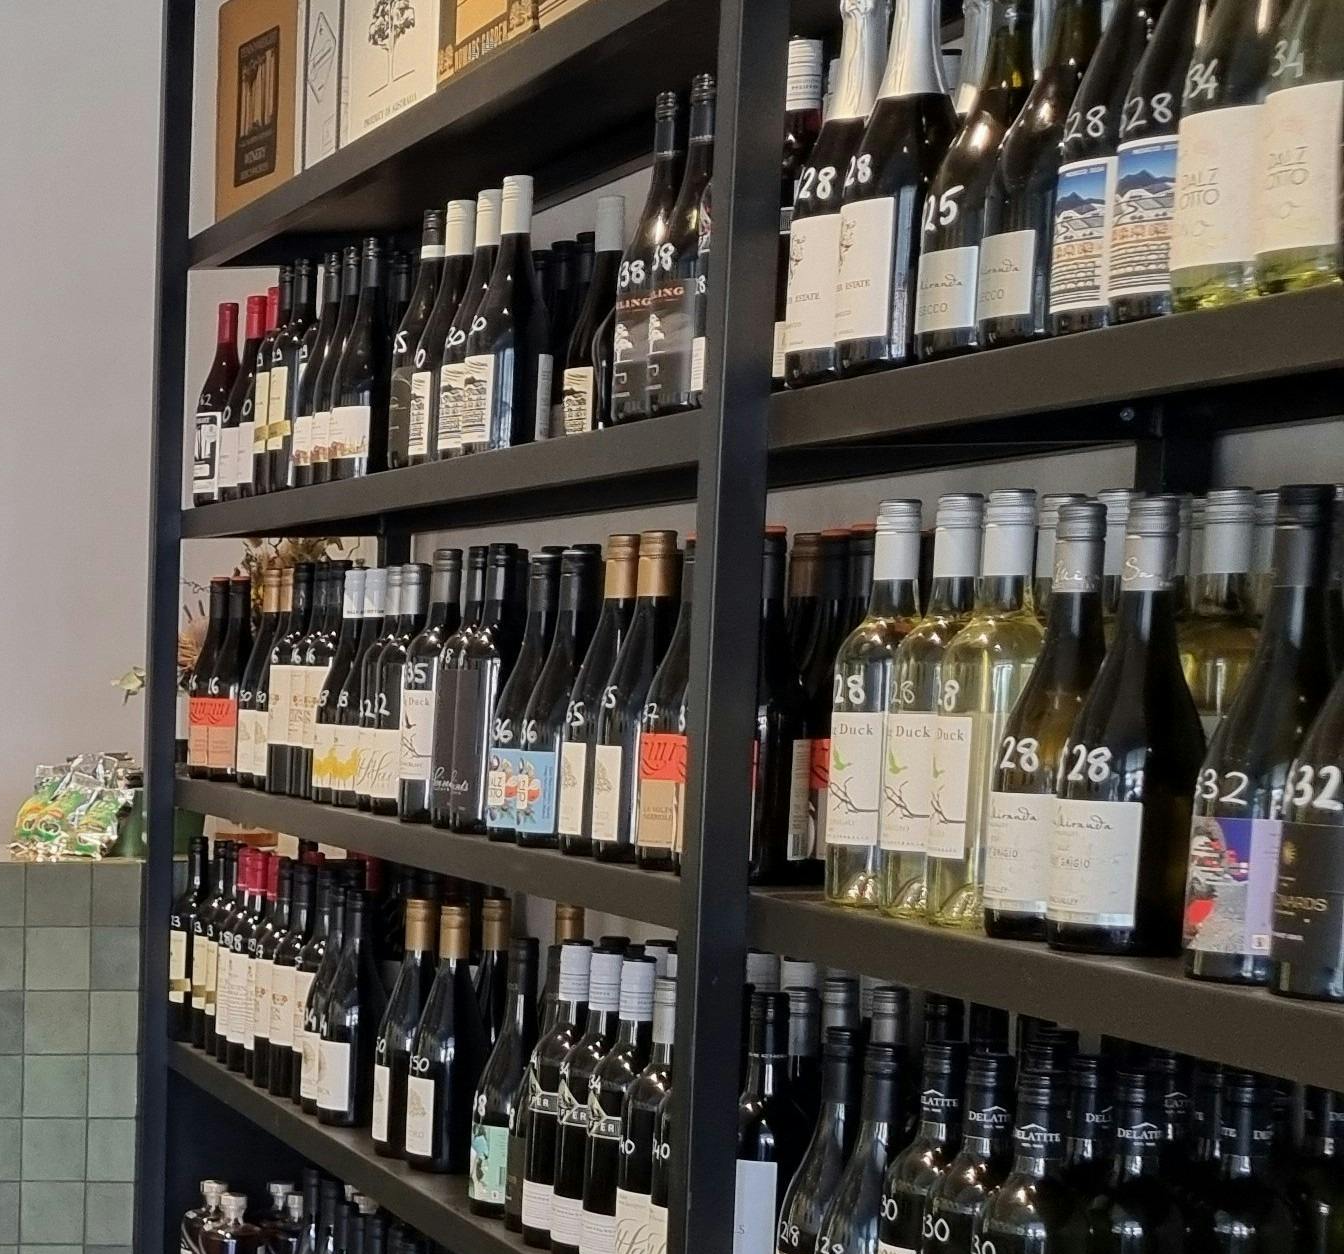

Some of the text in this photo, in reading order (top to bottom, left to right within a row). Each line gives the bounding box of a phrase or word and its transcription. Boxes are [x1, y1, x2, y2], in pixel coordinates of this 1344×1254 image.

[798, 166, 837, 200] 28
[834, 673, 865, 705] 28
[840, 723, 873, 736] Duck
[896, 725, 931, 738] Duck
[1000, 736, 1039, 773] 28
[1067, 743, 1112, 783] 28
